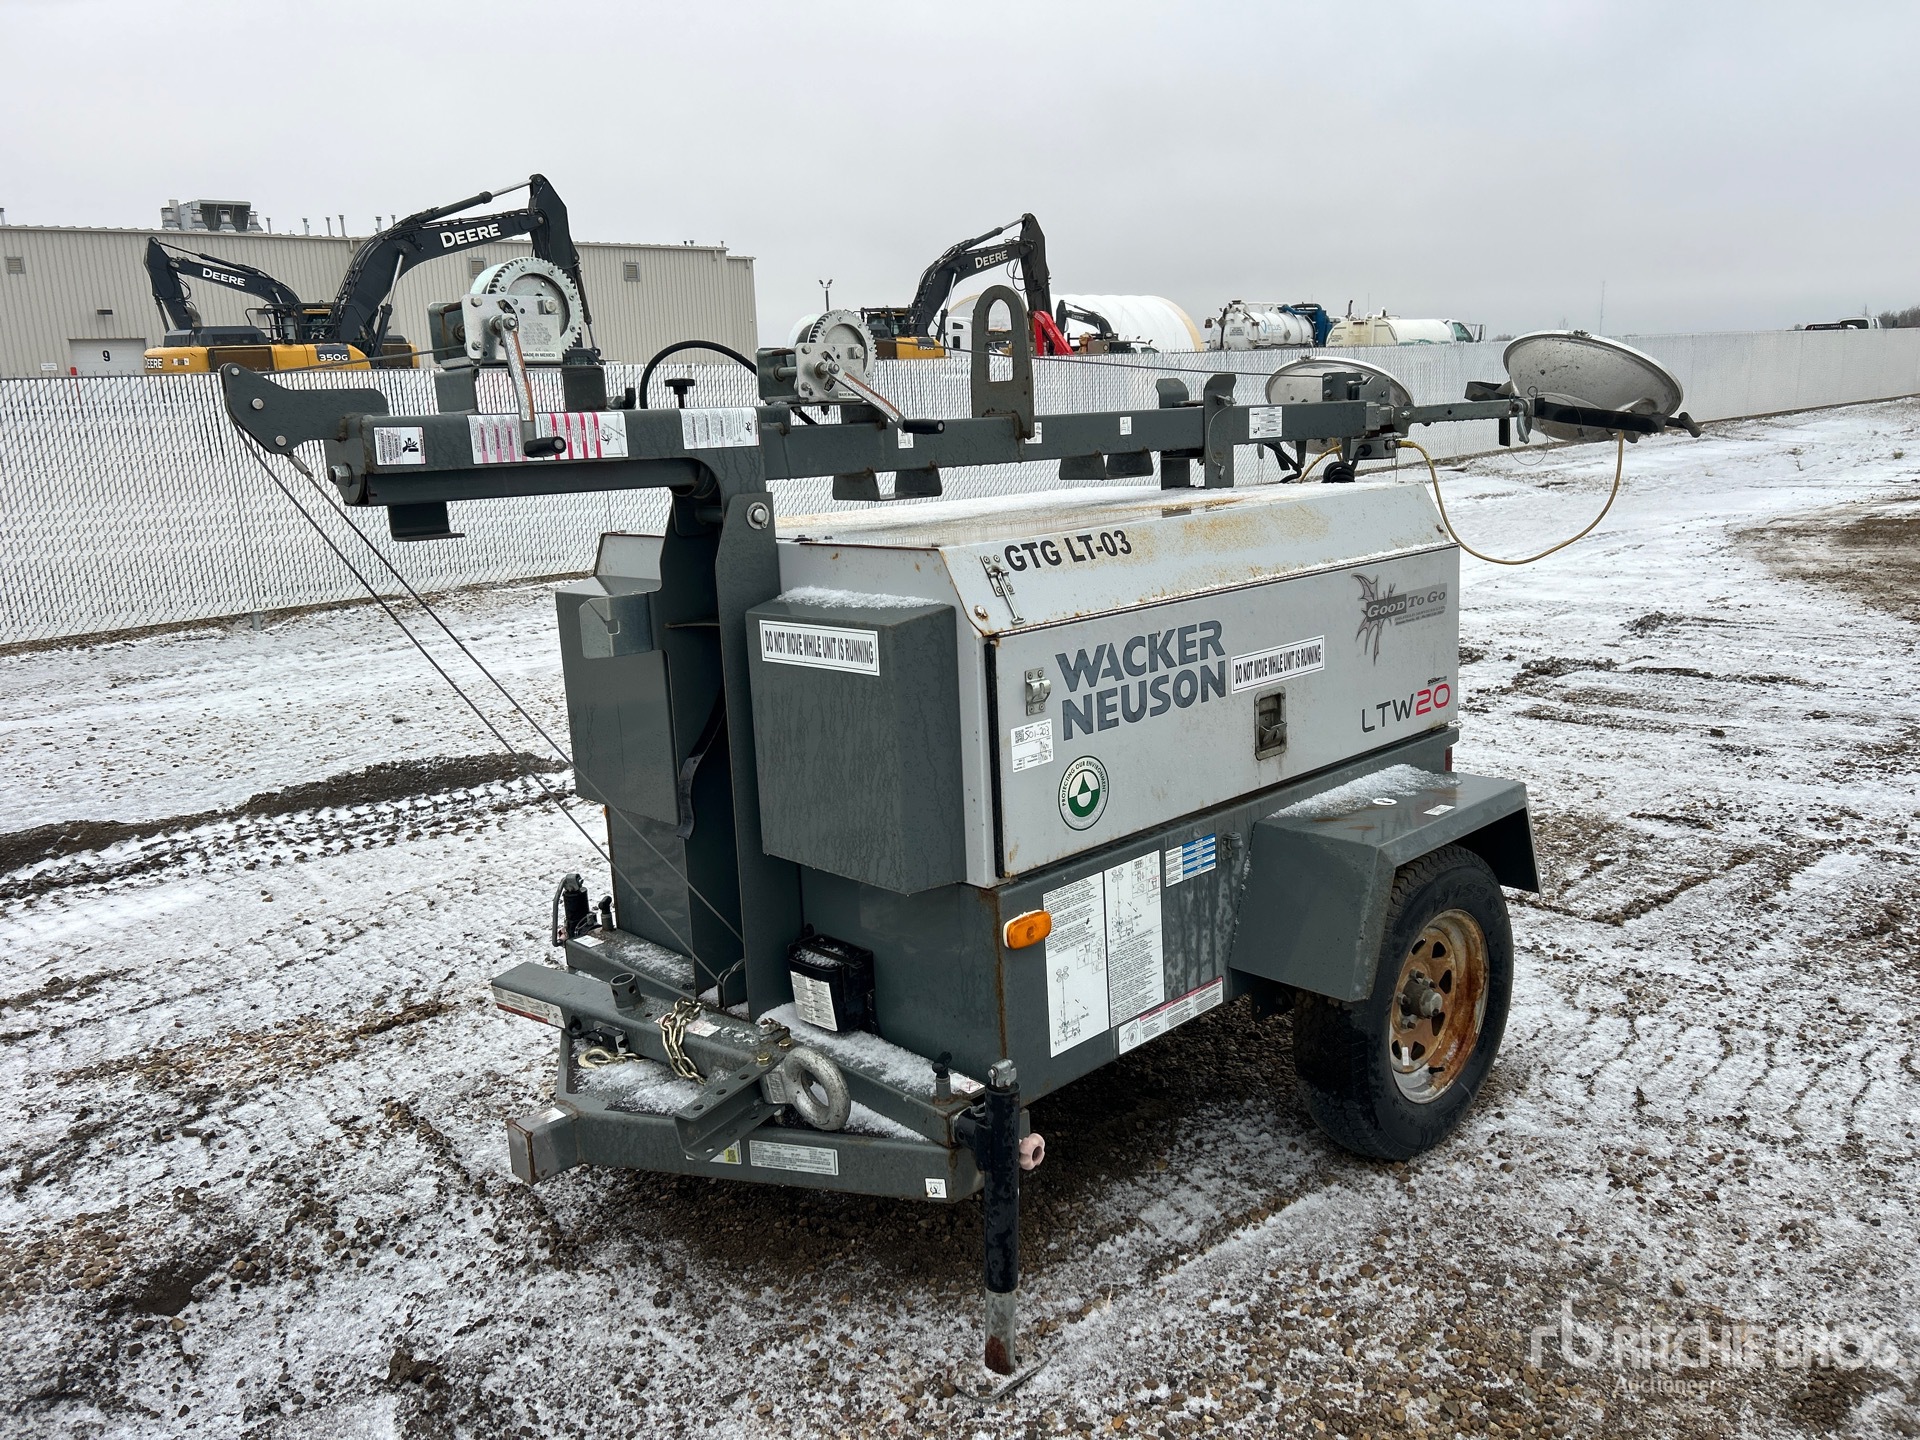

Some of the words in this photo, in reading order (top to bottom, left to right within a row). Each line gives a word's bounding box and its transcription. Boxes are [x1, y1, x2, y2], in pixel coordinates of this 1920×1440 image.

[440, 224, 501, 248] DEERE
[202, 267, 246, 286] DEERE
[974, 250, 1008, 269] DEERE
[102, 350, 111, 362] 9
[319, 353, 348, 362] 350G
[1004, 540, 1062, 572] GTG
[1064, 530, 1132, 562] LT-03
[765, 630, 773, 652] DO
[774, 632, 785, 653] NOT
[786, 632, 803, 655] MOVE
[803, 634, 821, 657] WHILE
[822, 636, 836, 659] UNIT
[838, 638, 844, 660] IS
[845, 639, 873, 664] RUNNING
[1054, 620, 1226, 692] WACKER
[1235, 664, 1242, 684] DO
[1243, 661, 1253, 682] NOT
[1254, 658, 1267, 679] MOVE
[1268, 654, 1282, 676] WHILE
[1284, 651, 1294, 671] UNIT
[1296, 649, 1300, 668] IS
[1301, 644, 1321, 667] RUNNING
[1062, 660, 1226, 741] NEUSON
[1362, 684, 1450, 732] LTW20
[1062, 768, 1076, 806] PROTECTING
[1075, 760, 1085, 770] OUR
[1086, 760, 1106, 793] ENVIRONMENT
